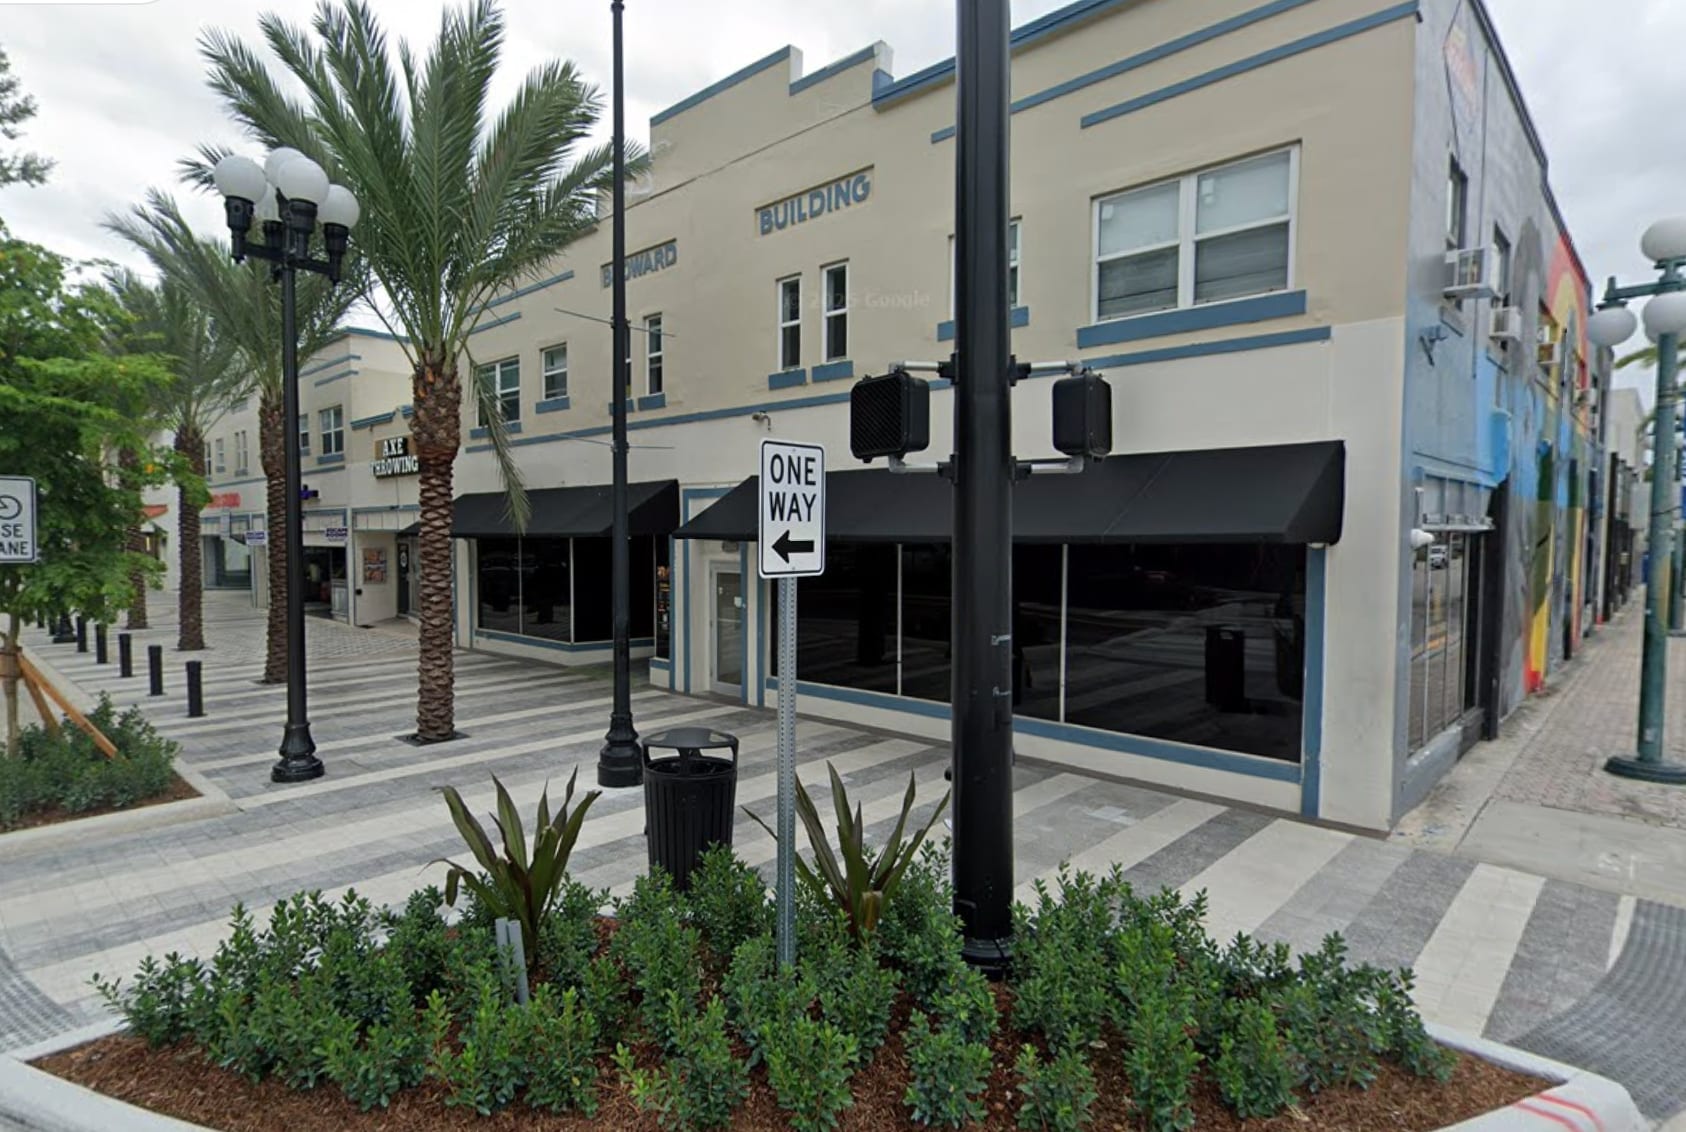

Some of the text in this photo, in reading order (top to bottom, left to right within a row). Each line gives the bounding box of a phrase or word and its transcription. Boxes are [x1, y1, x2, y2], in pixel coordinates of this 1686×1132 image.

[760, 175, 870, 235] BUILDING
[603, 243, 676, 288] BOWARD
[383, 437, 404, 456] AXE
[370, 455, 419, 475] THROWING
[770, 453, 816, 485] ONE
[769, 491, 816, 522] WAY
